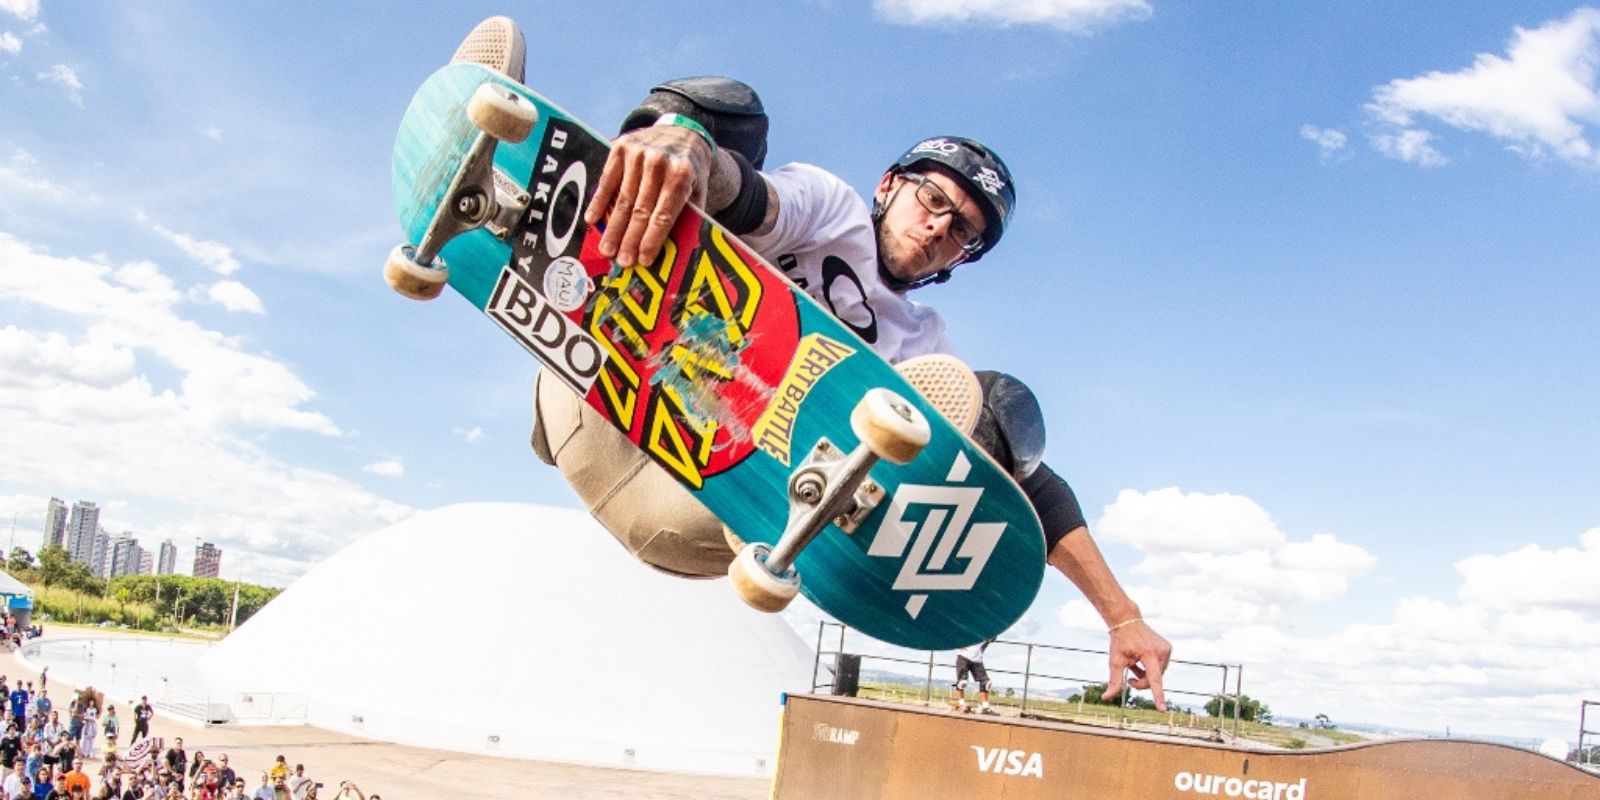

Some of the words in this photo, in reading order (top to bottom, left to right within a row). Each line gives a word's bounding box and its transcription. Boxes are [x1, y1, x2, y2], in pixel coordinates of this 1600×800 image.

[518, 128, 568, 275] OAKLEY
[557, 261, 575, 307] MAUI
[795, 337, 852, 388] VERT
[758, 384, 805, 463] BATTLE
[970, 744, 1043, 778] VISA
[1174, 771, 1307, 800] ourocard
